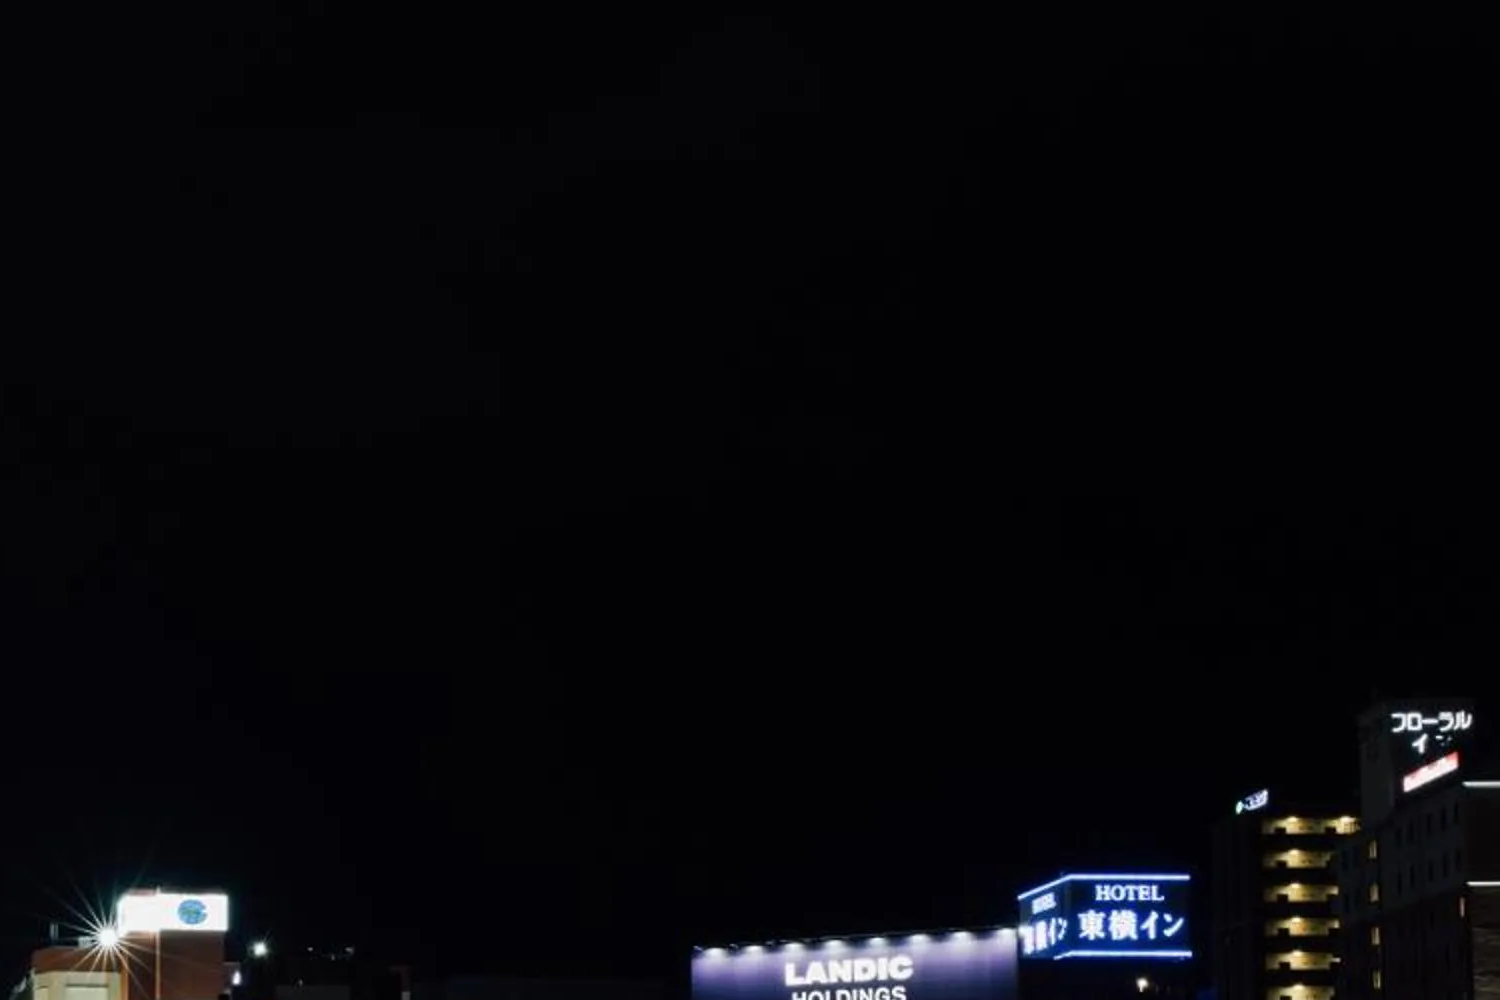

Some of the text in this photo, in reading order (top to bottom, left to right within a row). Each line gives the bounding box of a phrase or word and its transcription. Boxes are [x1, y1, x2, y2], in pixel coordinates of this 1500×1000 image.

[1391, 710, 1472, 732] フローラル
[1095, 884, 1165, 901] HOTEL
[1077, 909, 1184, 941] 東横イン
[785, 955, 914, 987] LANDIC
